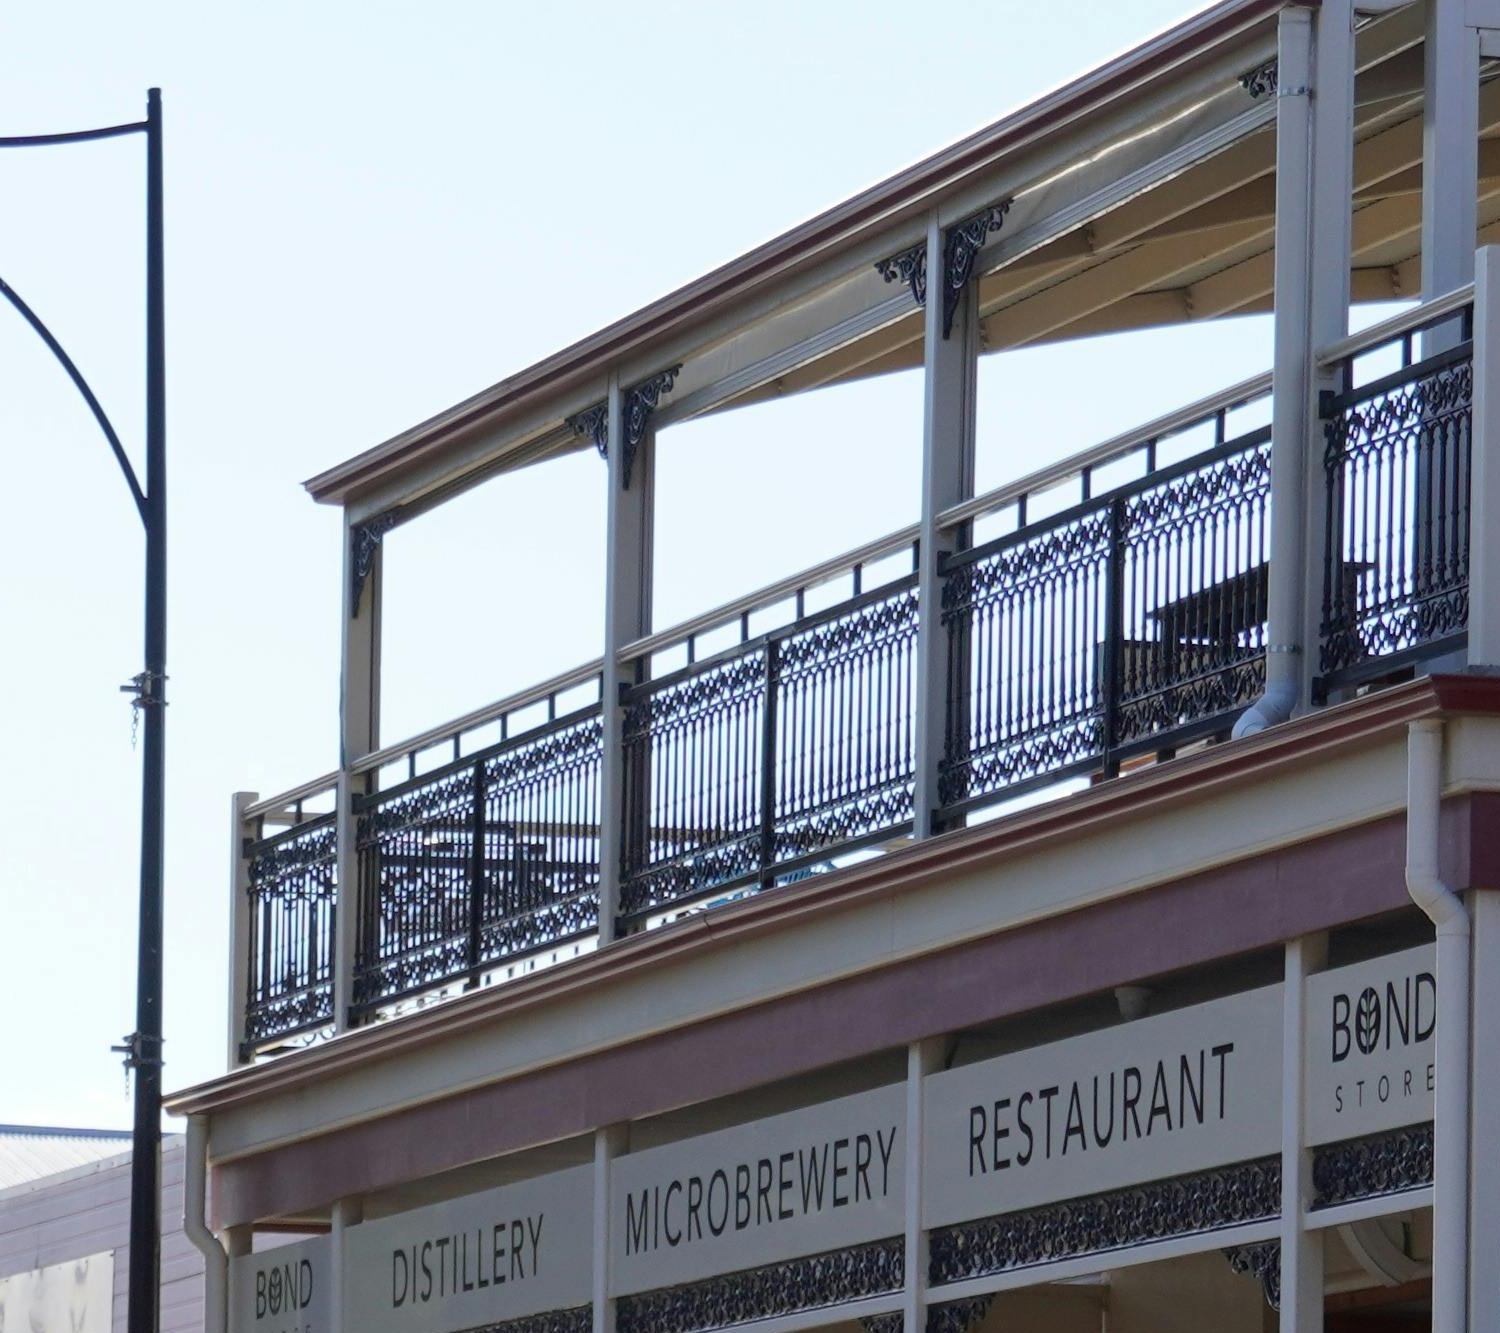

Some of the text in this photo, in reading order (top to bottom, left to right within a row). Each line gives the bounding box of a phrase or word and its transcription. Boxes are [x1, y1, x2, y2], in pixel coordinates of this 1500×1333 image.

[1332, 972, 1436, 1063] BOND
[969, 1042, 1234, 1177] RESTAURANT
[1335, 1063, 1435, 1113] STORE
[625, 1126, 898, 1257] MICROBREWERY
[255, 1259, 313, 1320] BOND
[392, 1214, 543, 1309] DISTILLERY
